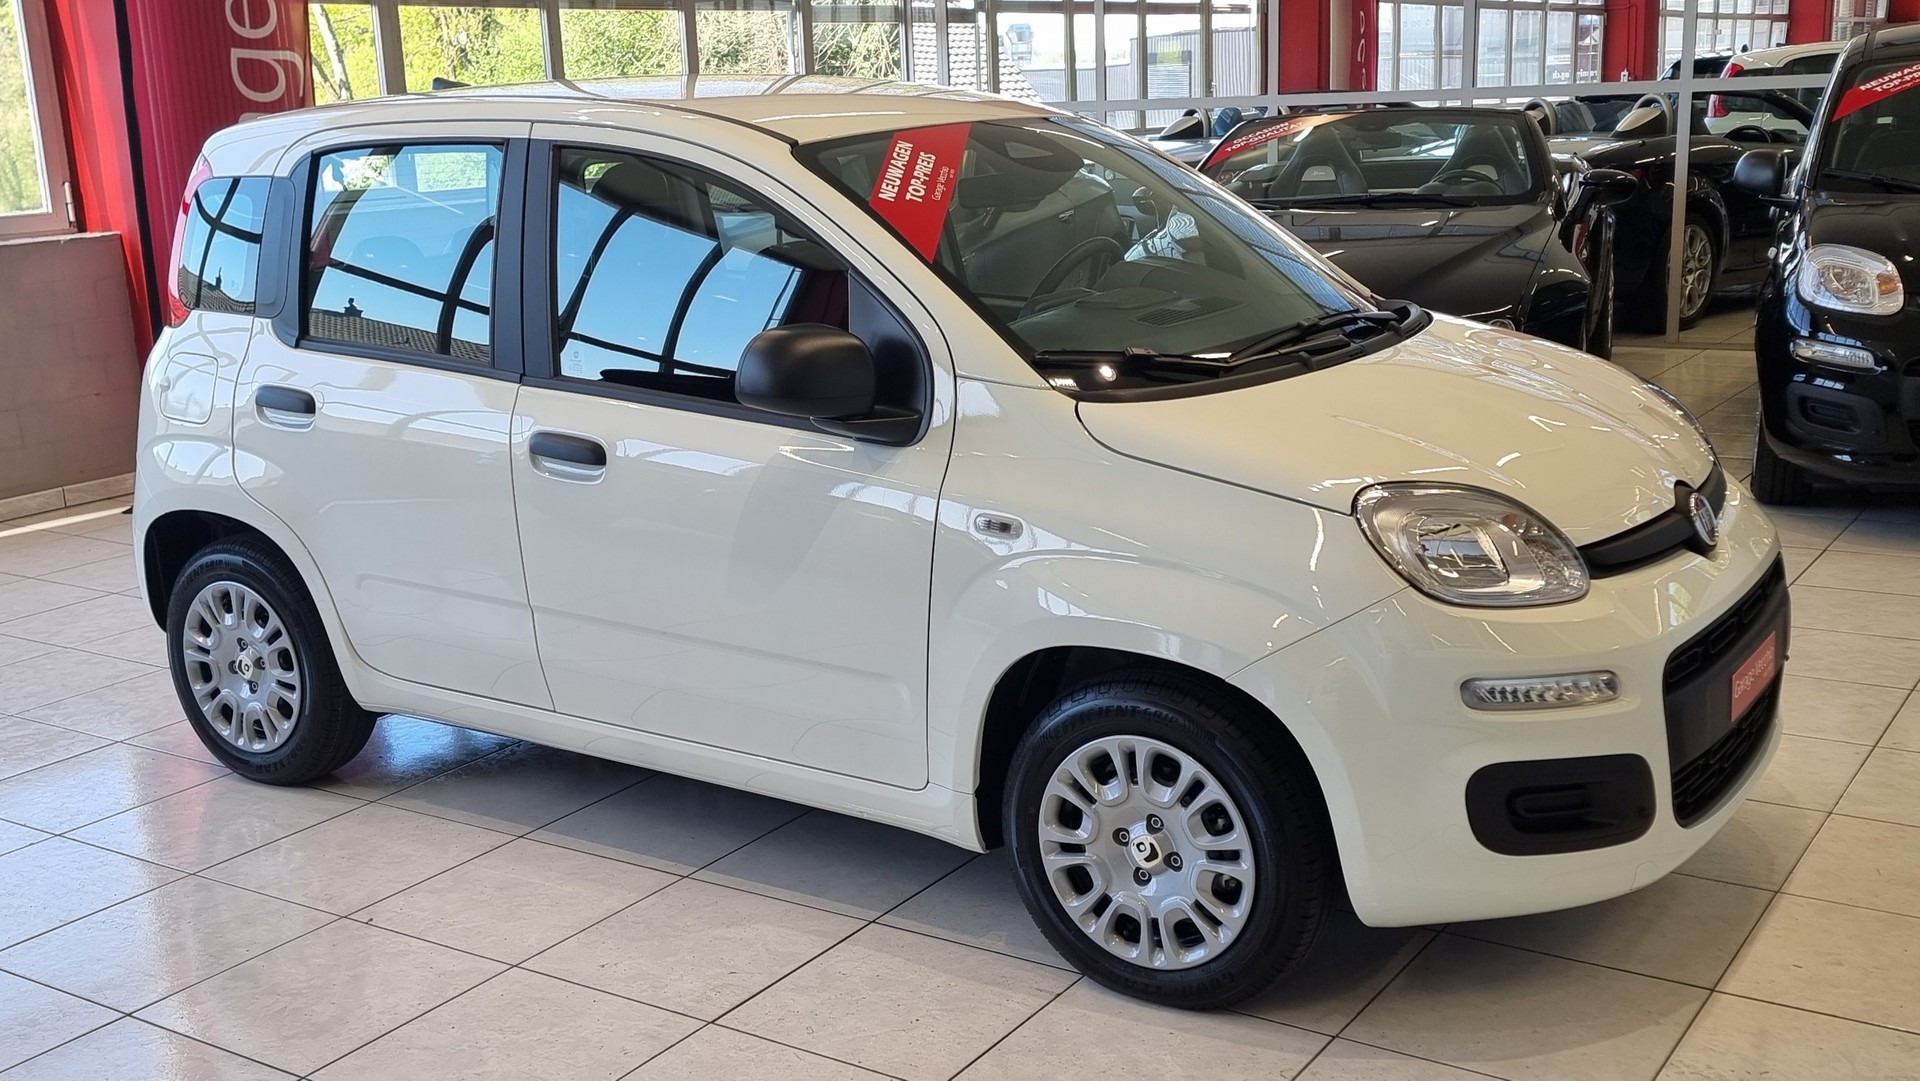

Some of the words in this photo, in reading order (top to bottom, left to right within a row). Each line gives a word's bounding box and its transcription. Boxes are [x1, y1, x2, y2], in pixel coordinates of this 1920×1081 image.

[1233, 121, 1289, 144] OCCASION
[878, 140, 914, 202] NEUWAGEN
[905, 151, 937, 203] TOP-PREIS
[931, 182, 947, 201] Garage
[1734, 668, 1755, 698] Garage
